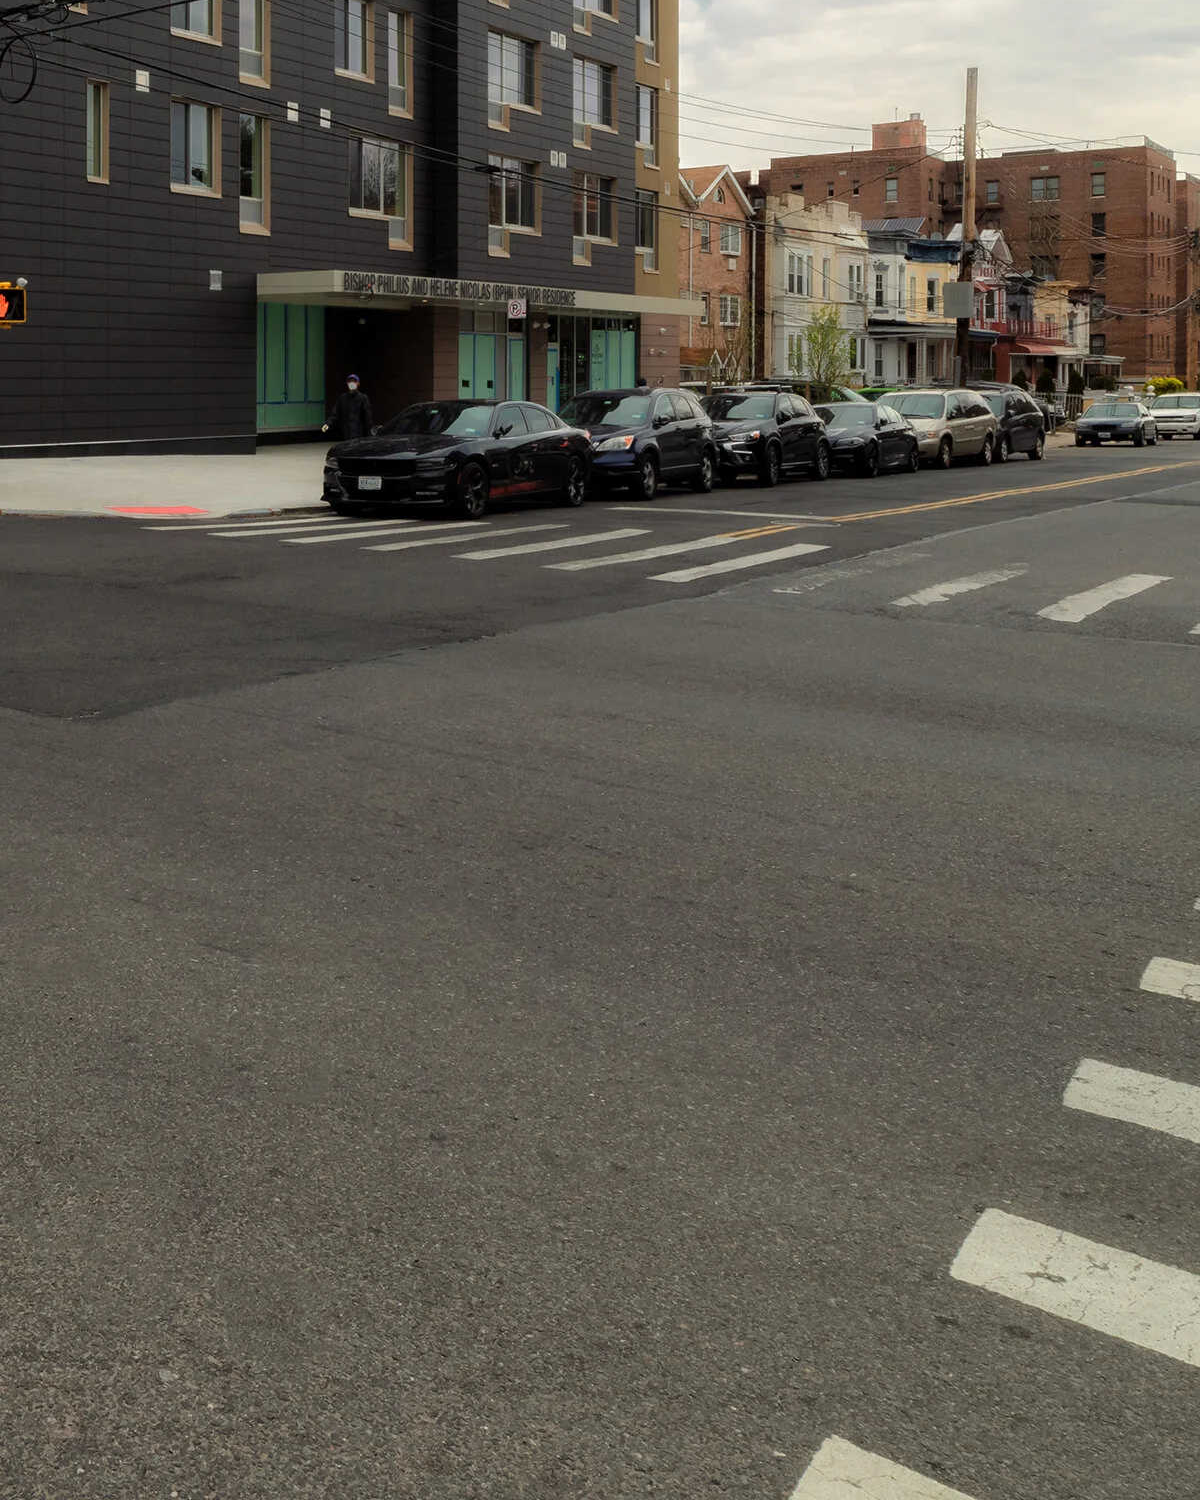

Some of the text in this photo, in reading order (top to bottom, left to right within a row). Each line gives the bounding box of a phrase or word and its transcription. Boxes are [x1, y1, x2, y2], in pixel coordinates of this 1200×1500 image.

[343, 272, 376, 292] BISHOP
[377, 274, 410, 295] PHILIUS
[411, 277, 428, 296] AND
[430, 279, 459, 298] HELENE
[460, 281, 491, 300] NICOLAS
[517, 286, 541, 304] SENIOR
[542, 288, 576, 306] RESIDENCE
